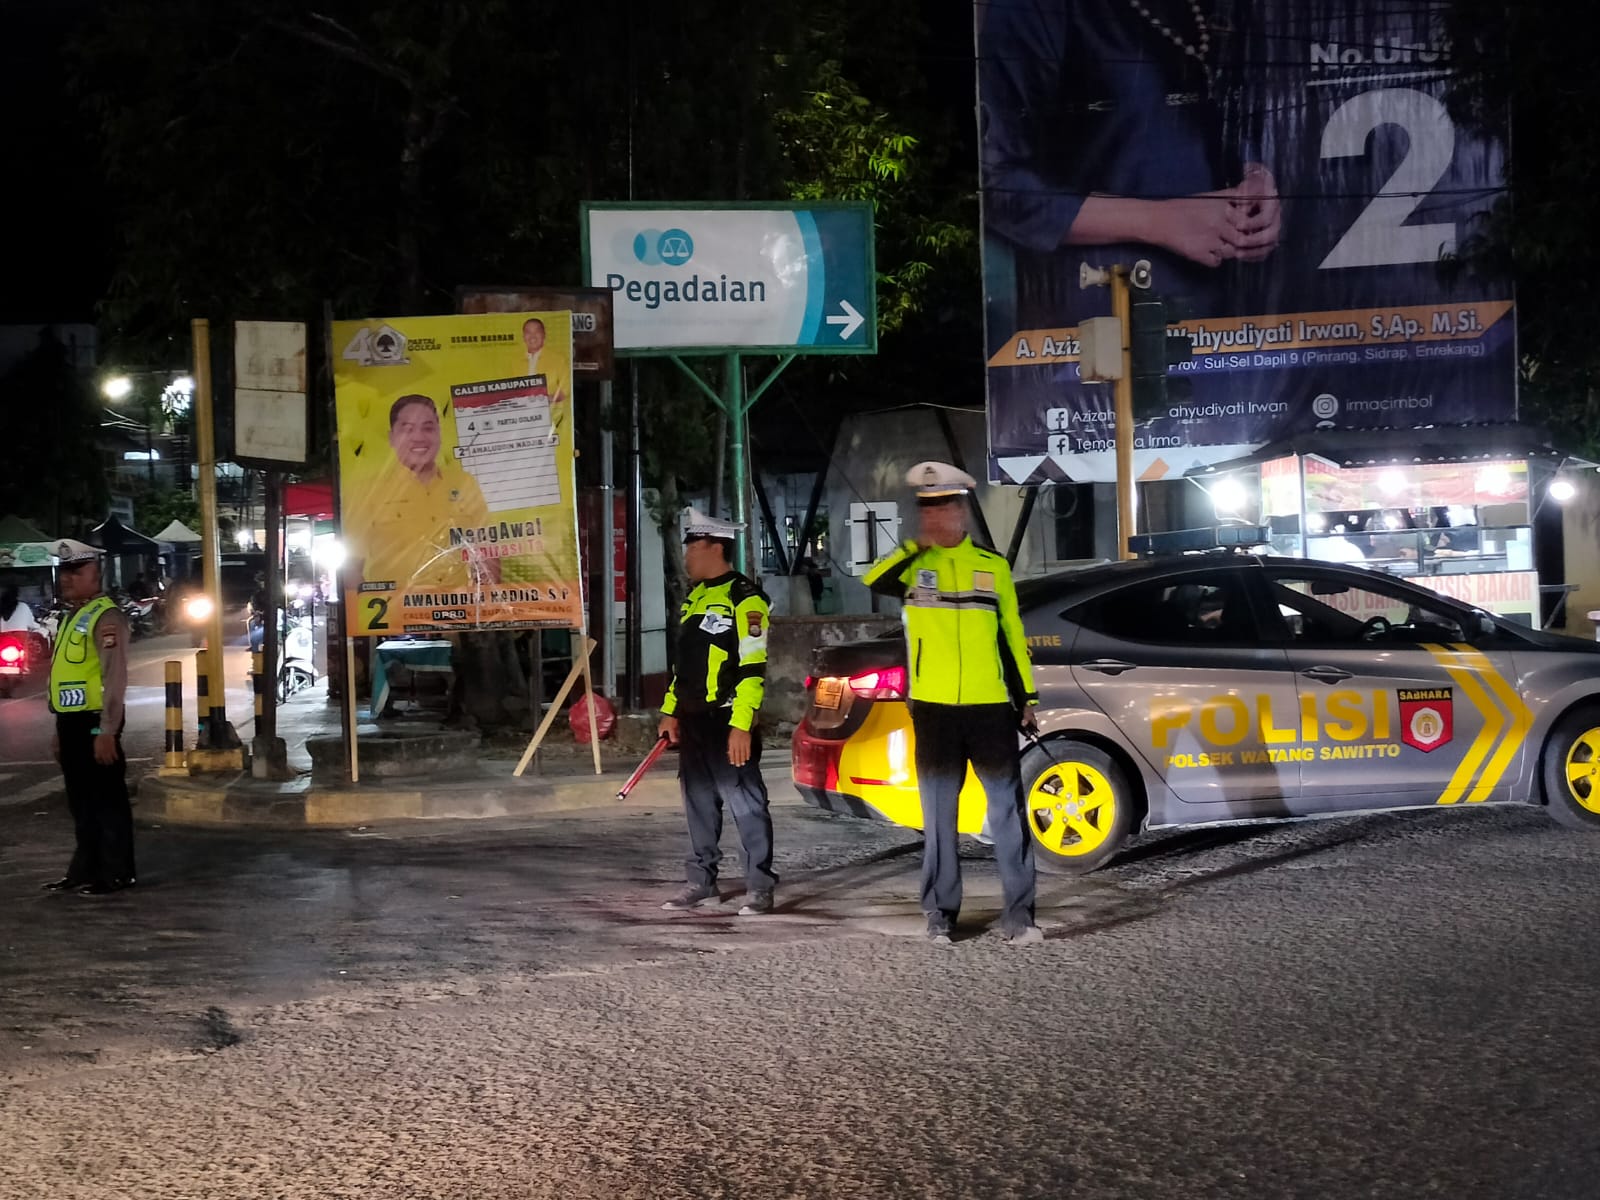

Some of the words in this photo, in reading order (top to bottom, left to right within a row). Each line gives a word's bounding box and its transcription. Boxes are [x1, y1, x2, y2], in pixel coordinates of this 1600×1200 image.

[1317, 87, 1456, 269] 2
[606, 274, 765, 309] Pegadaian
[572, 315, 592, 330] NG
[1299, 320, 1364, 342] Irwan,
[1016, 338, 1036, 358] A.
[1204, 355, 1250, 369] Sul-Sel
[1254, 353, 1286, 369] Dapil
[1290, 352, 1298, 365] 9
[1302, 348, 1360, 366] (Pinrang,
[454, 384, 486, 397] CALEG
[487, 377, 543, 393] KABUPATEN
[1168, 400, 1245, 419] ahyudiyati
[1248, 400, 1288, 414] Irwan
[1346, 395, 1433, 412] irmacimbol
[467, 421, 476, 431] 4
[1149, 434, 1181, 446] Irma
[1477, 573, 1531, 602] BAKAR
[367, 597, 390, 630] 2
[1399, 690, 1451, 700] SABHARA
[1152, 689, 1390, 747] POLISI
[1164, 751, 1233, 769] POLSEK
[1241, 748, 1315, 763] WATANG
[1320, 744, 1401, 760] SAWITTO
